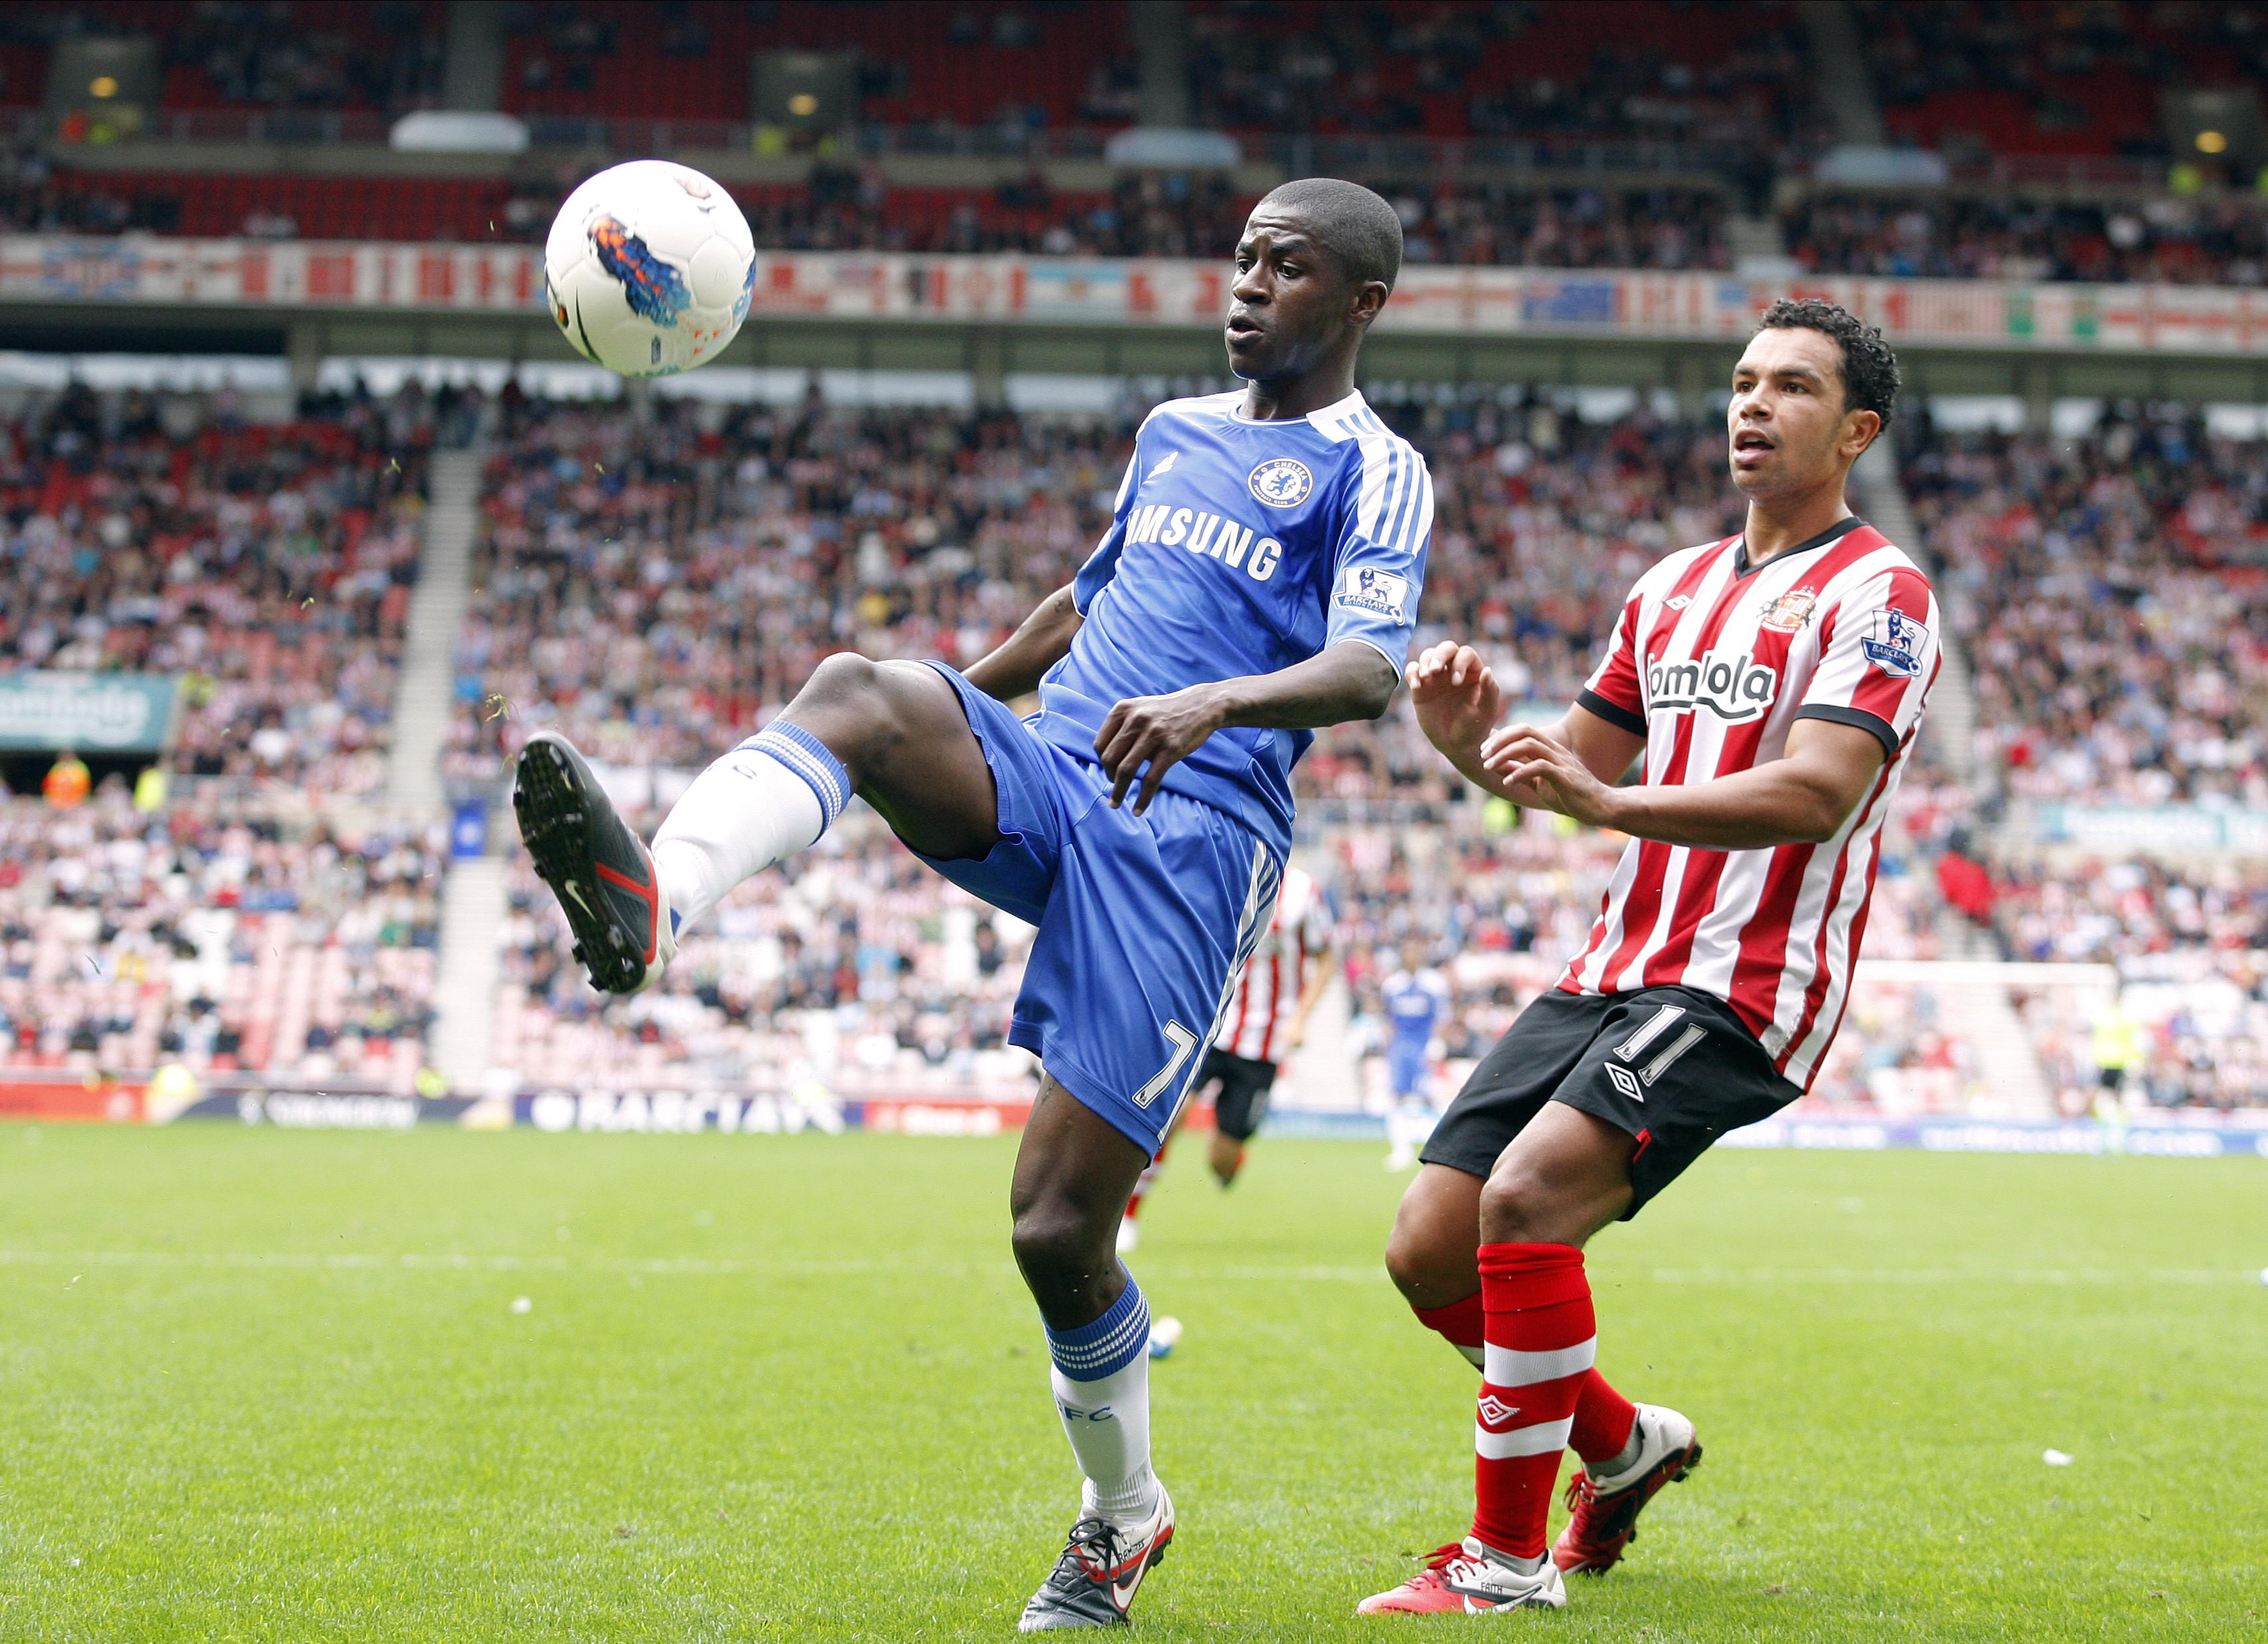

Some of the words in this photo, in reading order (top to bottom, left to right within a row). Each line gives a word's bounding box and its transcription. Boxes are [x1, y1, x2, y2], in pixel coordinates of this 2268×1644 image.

[1273, 461, 1308, 481] CHELSEA
[1123, 504, 1283, 582] AMSUNG
[1344, 596, 1390, 612] BARCLAYS
[1872, 643, 1909, 665] BARCLAYS
[1612, 1003, 1709, 1088] 11
[1131, 1018, 1199, 1110] 7
[1057, 1400, 1114, 1422] FC
[1480, 1582, 1503, 1594] FAITH
